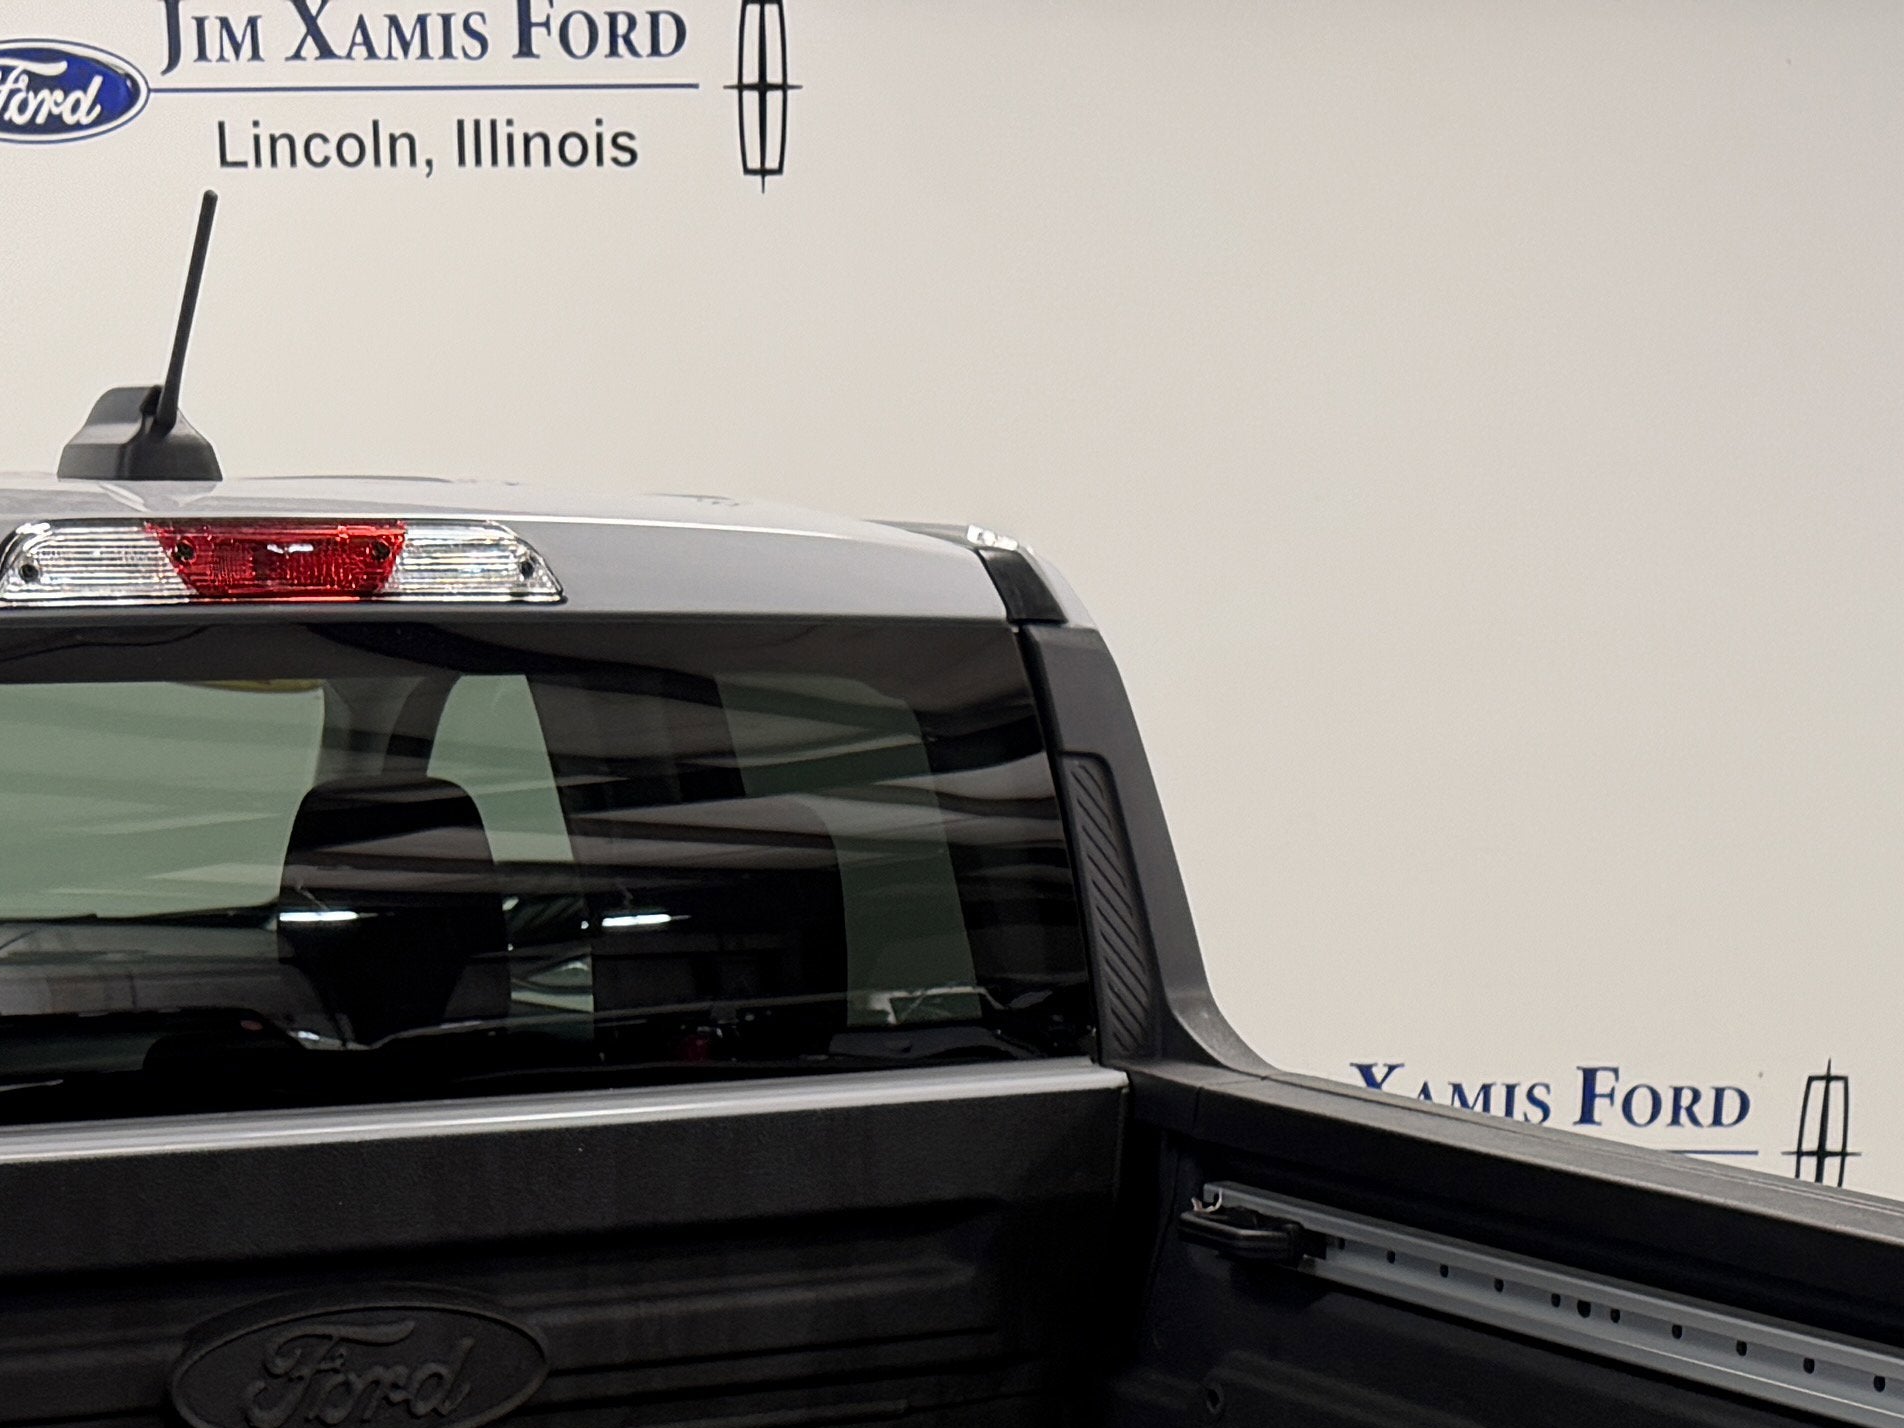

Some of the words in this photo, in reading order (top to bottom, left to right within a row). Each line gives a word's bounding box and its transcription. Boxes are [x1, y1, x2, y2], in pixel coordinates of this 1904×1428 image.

[161, 0, 264, 77] JIM
[284, 0, 488, 62] XAMIS
[512, 0, 687, 60] FORD
[217, 118, 434, 179] Lincoln,
[456, 118, 640, 169] Illinois
[1572, 1065, 1751, 1129] FORD
